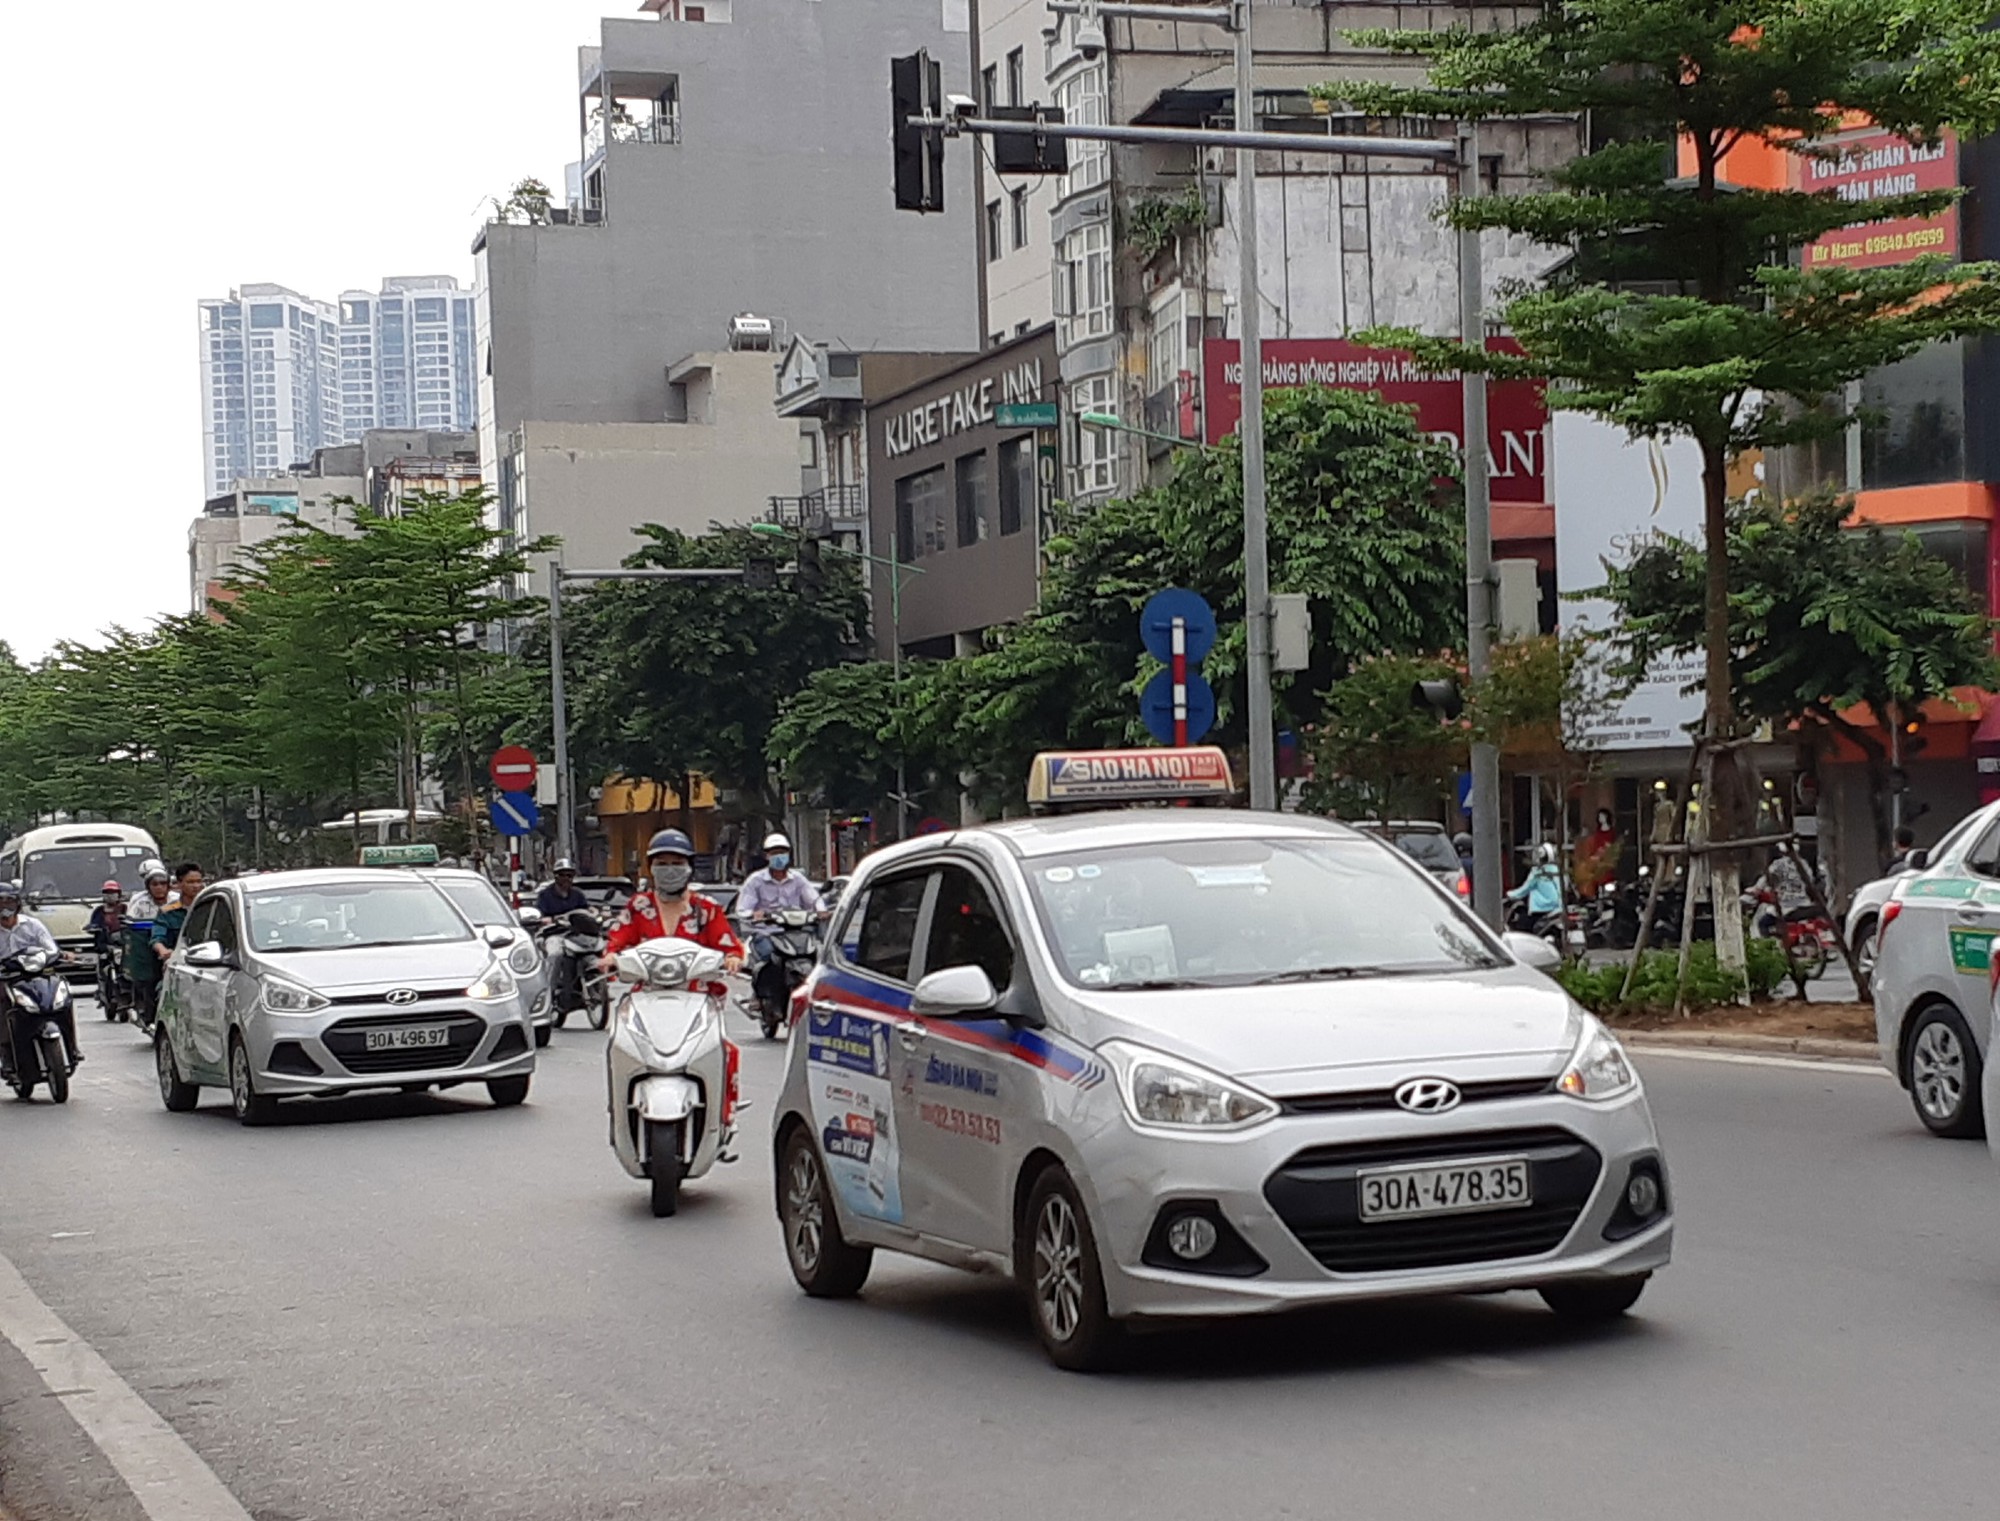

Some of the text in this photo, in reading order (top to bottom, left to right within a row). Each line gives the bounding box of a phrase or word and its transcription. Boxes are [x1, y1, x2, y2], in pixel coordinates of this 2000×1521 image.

[1873, 173, 1916, 199] HÀNG
[1263, 356, 1297, 384] HÀNG
[1300, 356, 1336, 384] NÔNG
[1338, 356, 1380, 388] NGHIỆP
[1381, 355, 1399, 383] VÀ
[884, 356, 1042, 458] KURETAKE INN
[1070, 758, 1121, 782] SAO
[1121, 757, 1151, 780] HA
[1152, 756, 1190, 779] NOI
[1365, 1165, 1524, 1213] 30A-478.35
